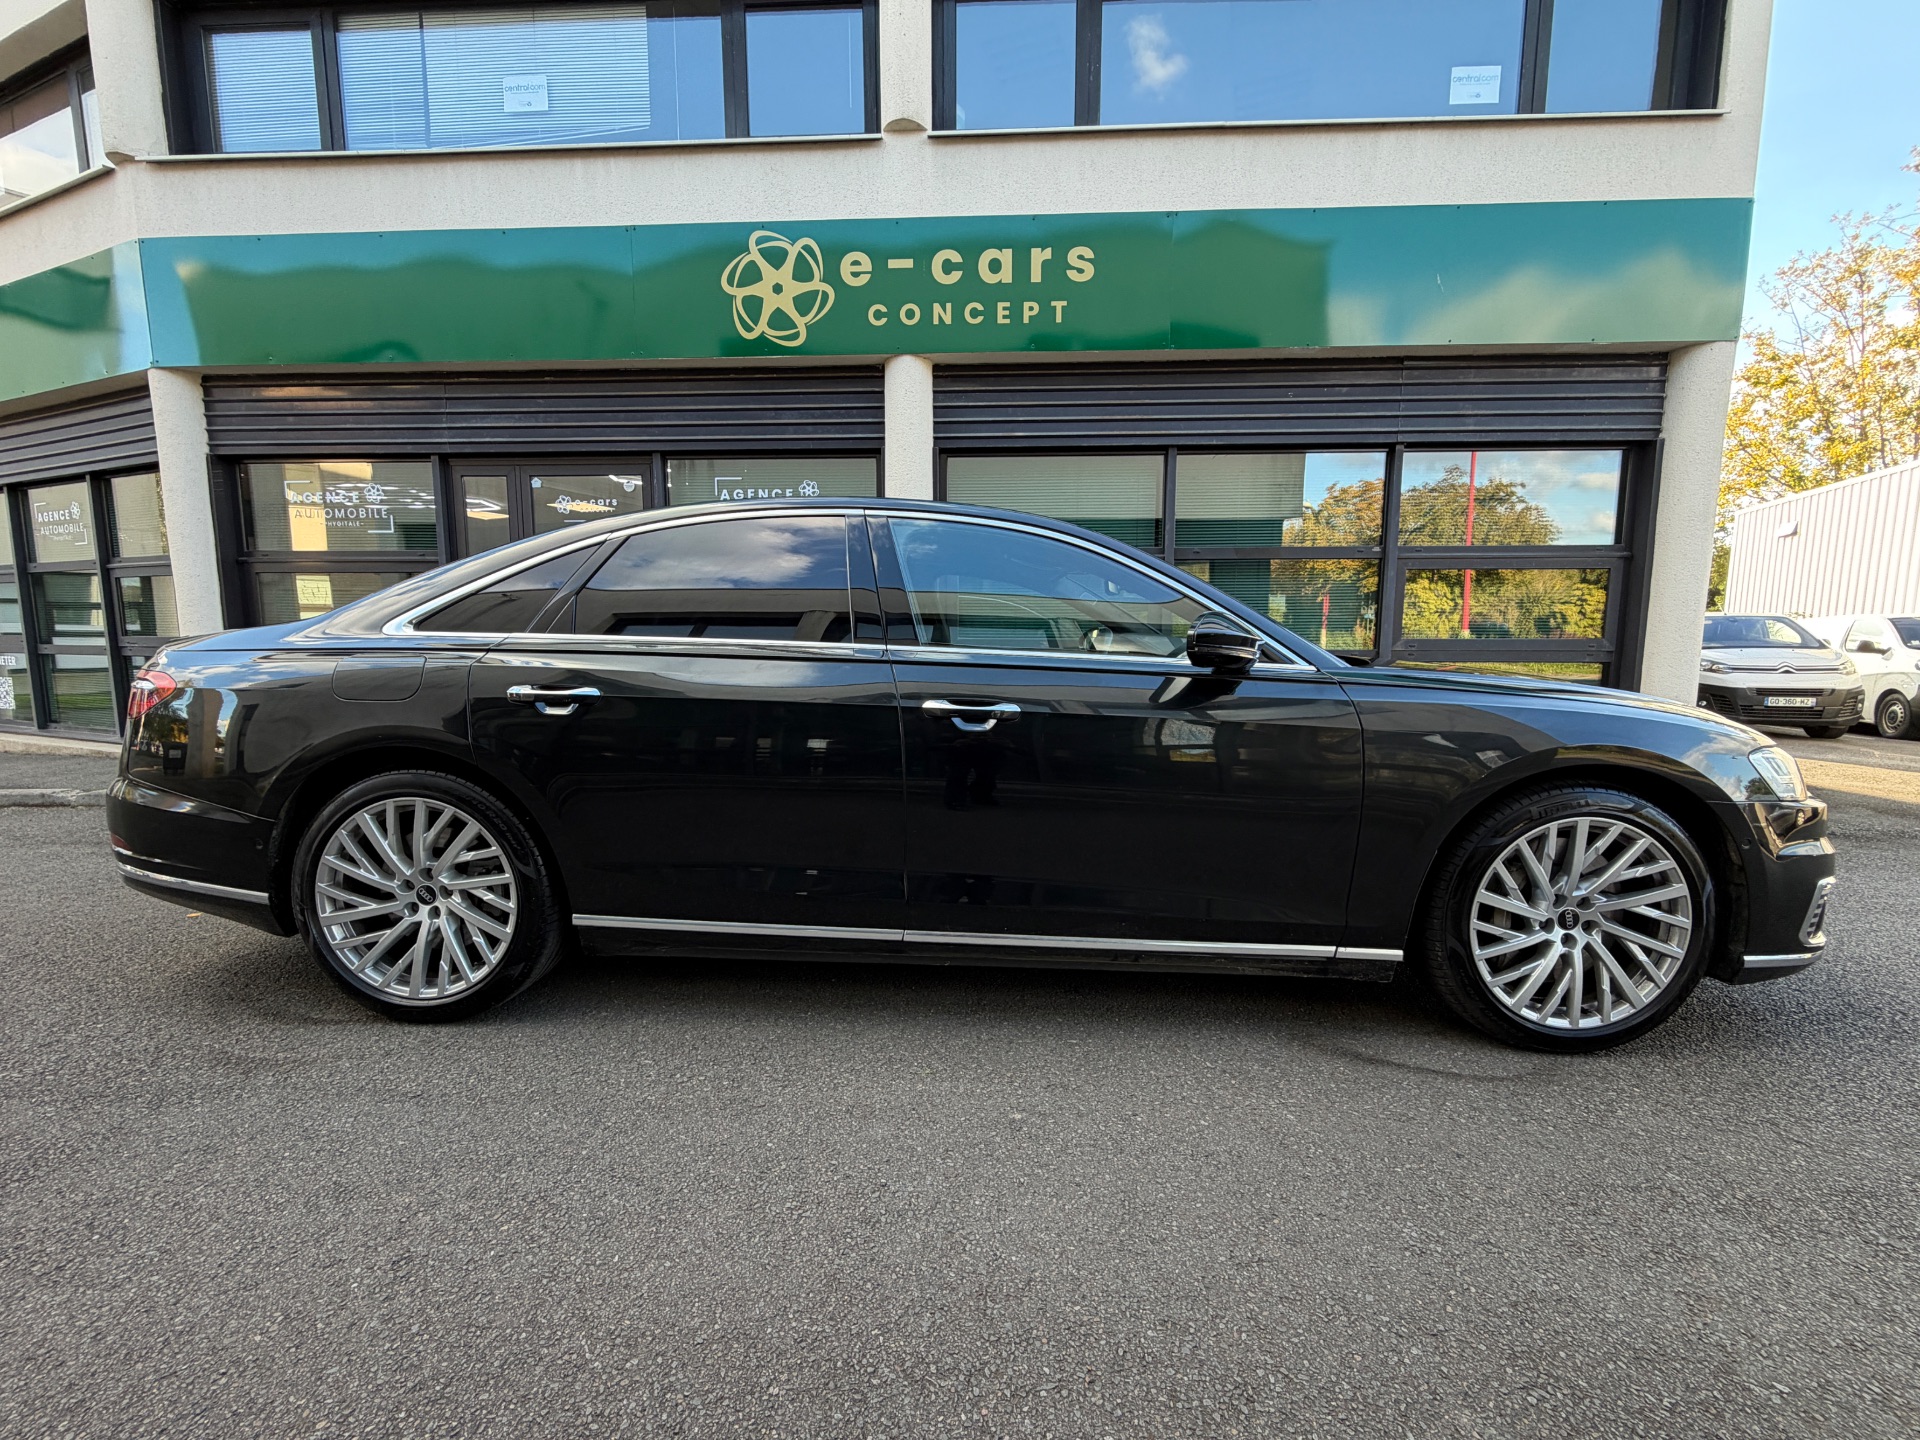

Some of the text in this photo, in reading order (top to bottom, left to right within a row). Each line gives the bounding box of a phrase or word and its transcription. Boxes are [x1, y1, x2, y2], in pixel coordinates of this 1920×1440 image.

[840, 246, 1095, 287] e-cars
[867, 300, 1068, 327] CONCEPT
[290, 491, 360, 504] AGENCE
[720, 488, 794, 500] AGENCE
[38, 509, 70, 523] AGENCE
[294, 507, 389, 519] AUTOMOBILE
[40, 522, 84, 535] AUTOMOBILE
